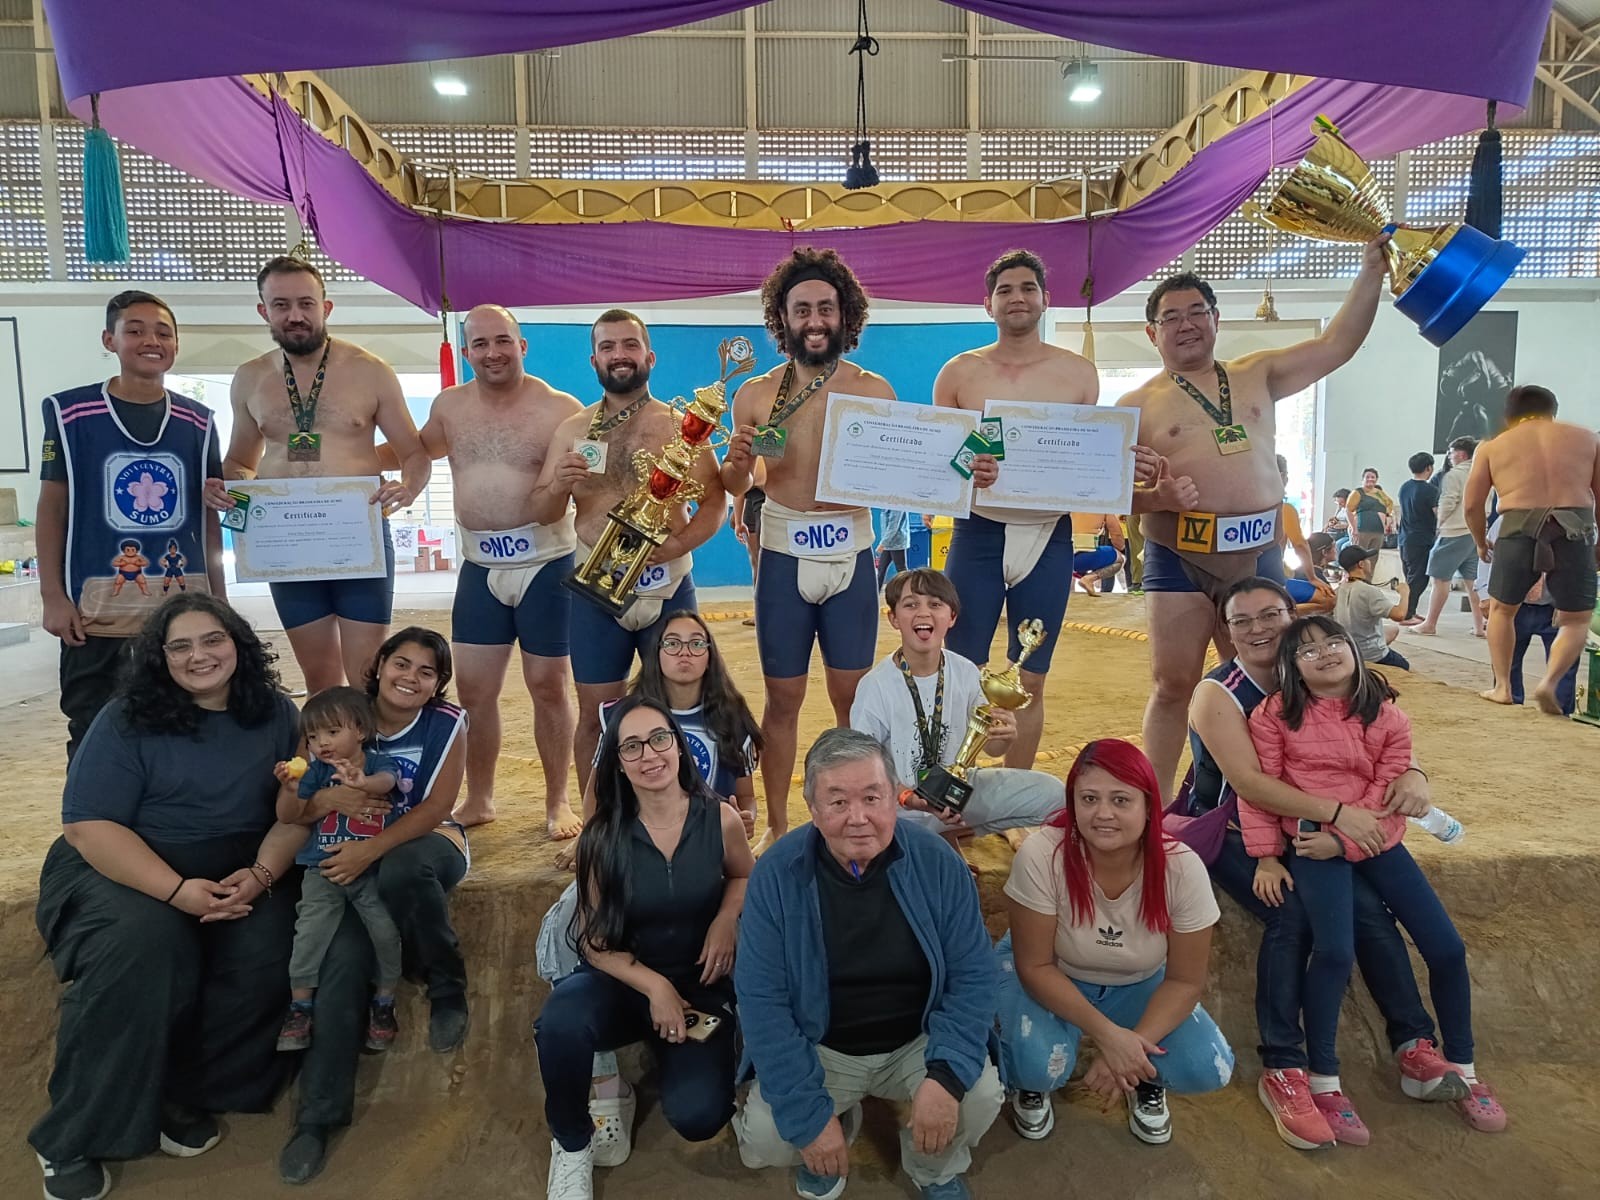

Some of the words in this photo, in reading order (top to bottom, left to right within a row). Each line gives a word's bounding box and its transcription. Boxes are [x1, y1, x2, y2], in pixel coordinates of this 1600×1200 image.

[880, 434, 924, 446] Certificado
[1037, 437, 1081, 447] Certificado
[139, 463, 174, 483] CENTRAL
[129, 510, 169, 524] SUMO
[284, 512, 327, 520] Certificado
[808, 524, 835, 549] NC
[1181, 516, 1211, 545] IV
[1239, 518, 1263, 544] NC
[489, 535, 516, 558] NC
[1095, 939, 1123, 948] adidas
